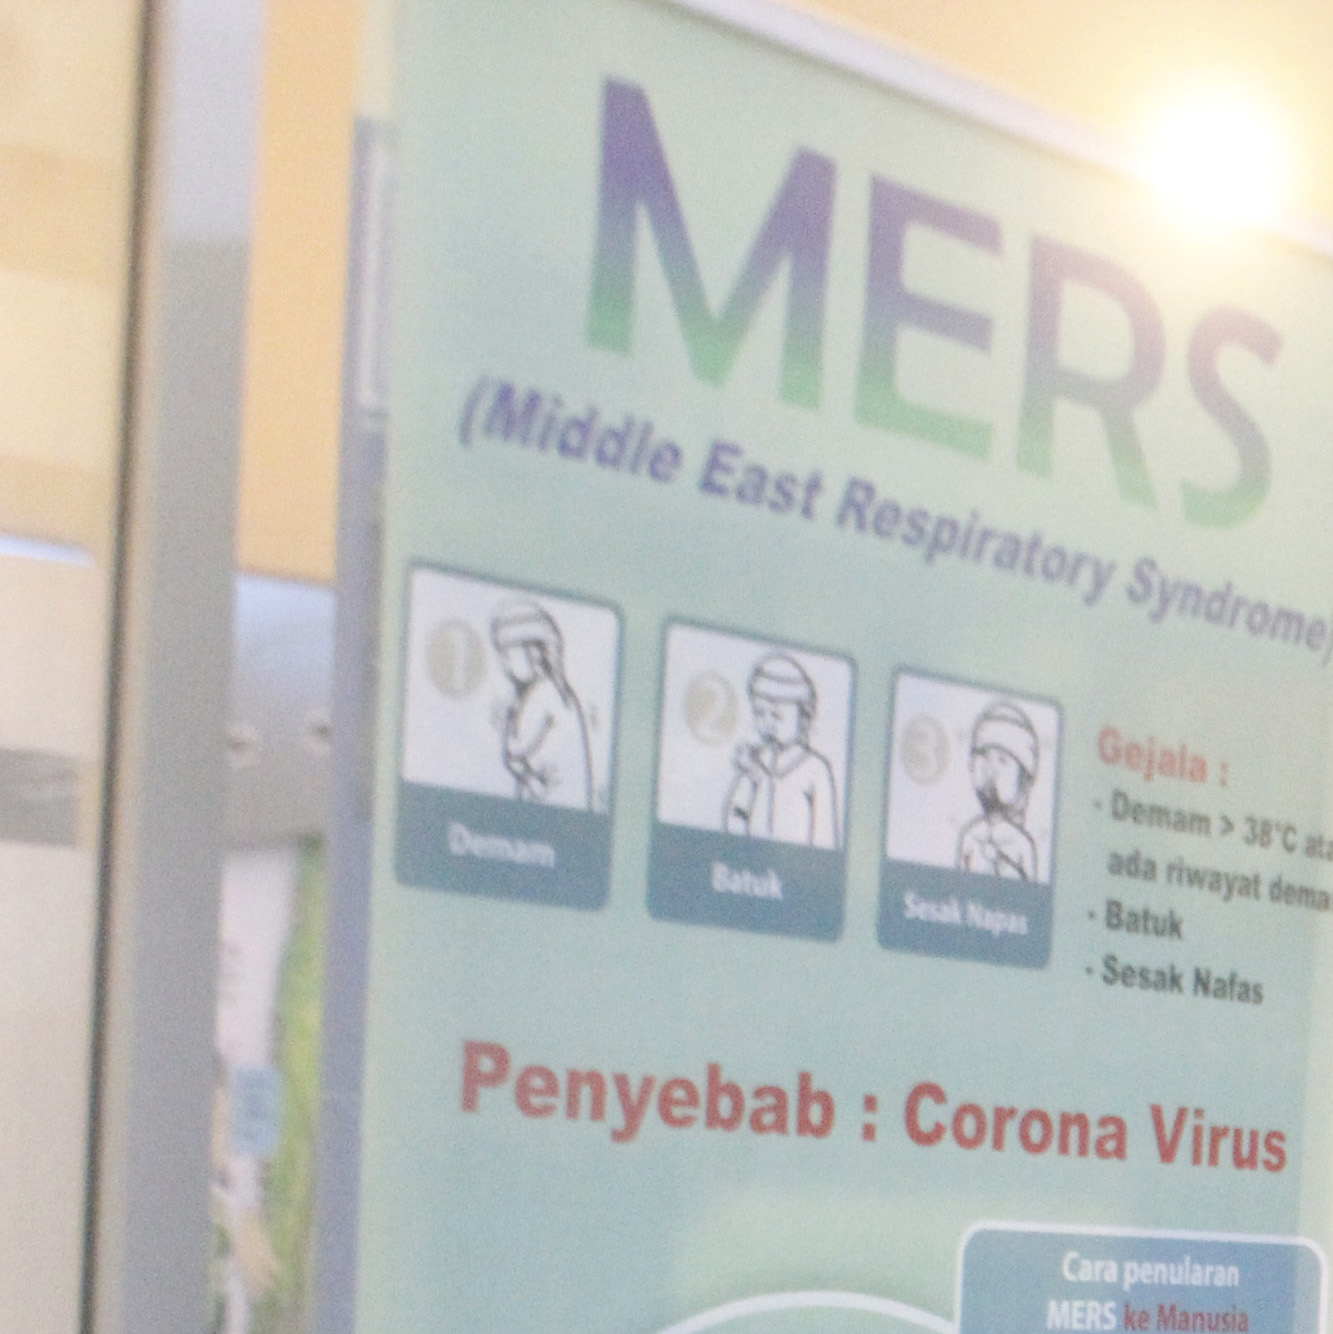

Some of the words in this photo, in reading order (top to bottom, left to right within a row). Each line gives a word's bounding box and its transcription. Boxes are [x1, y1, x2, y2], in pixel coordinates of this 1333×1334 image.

[584, 77, 1283, 531] MERS
[458, 374, 683, 484] (Middle
[699, 438, 824, 522] East
[836, 476, 1117, 607] Respiratory
[1098, 726, 1207, 782] Gejala
[1110, 788, 1211, 837] Demam
[711, 861, 783, 899] Batuk
[1108, 850, 1156, 882] ada
[1167, 856, 1261, 902] riwayat
[1105, 899, 1183, 940] Batuk
[1102, 953, 1184, 994] Sesak
[1193, 967, 1263, 1004] Nafas
[460, 1039, 835, 1143] Penyebab
[904, 1081, 1127, 1161] Corona
[1149, 1103, 1287, 1172] Virus
[1062, 1251, 1118, 1283] Cara
[1123, 1256, 1239, 1291] penularan
[1047, 1300, 1117, 1330] MERS
[1122, 1303, 1149, 1332] ke
[1156, 1304, 1250, 1333] Manusia
